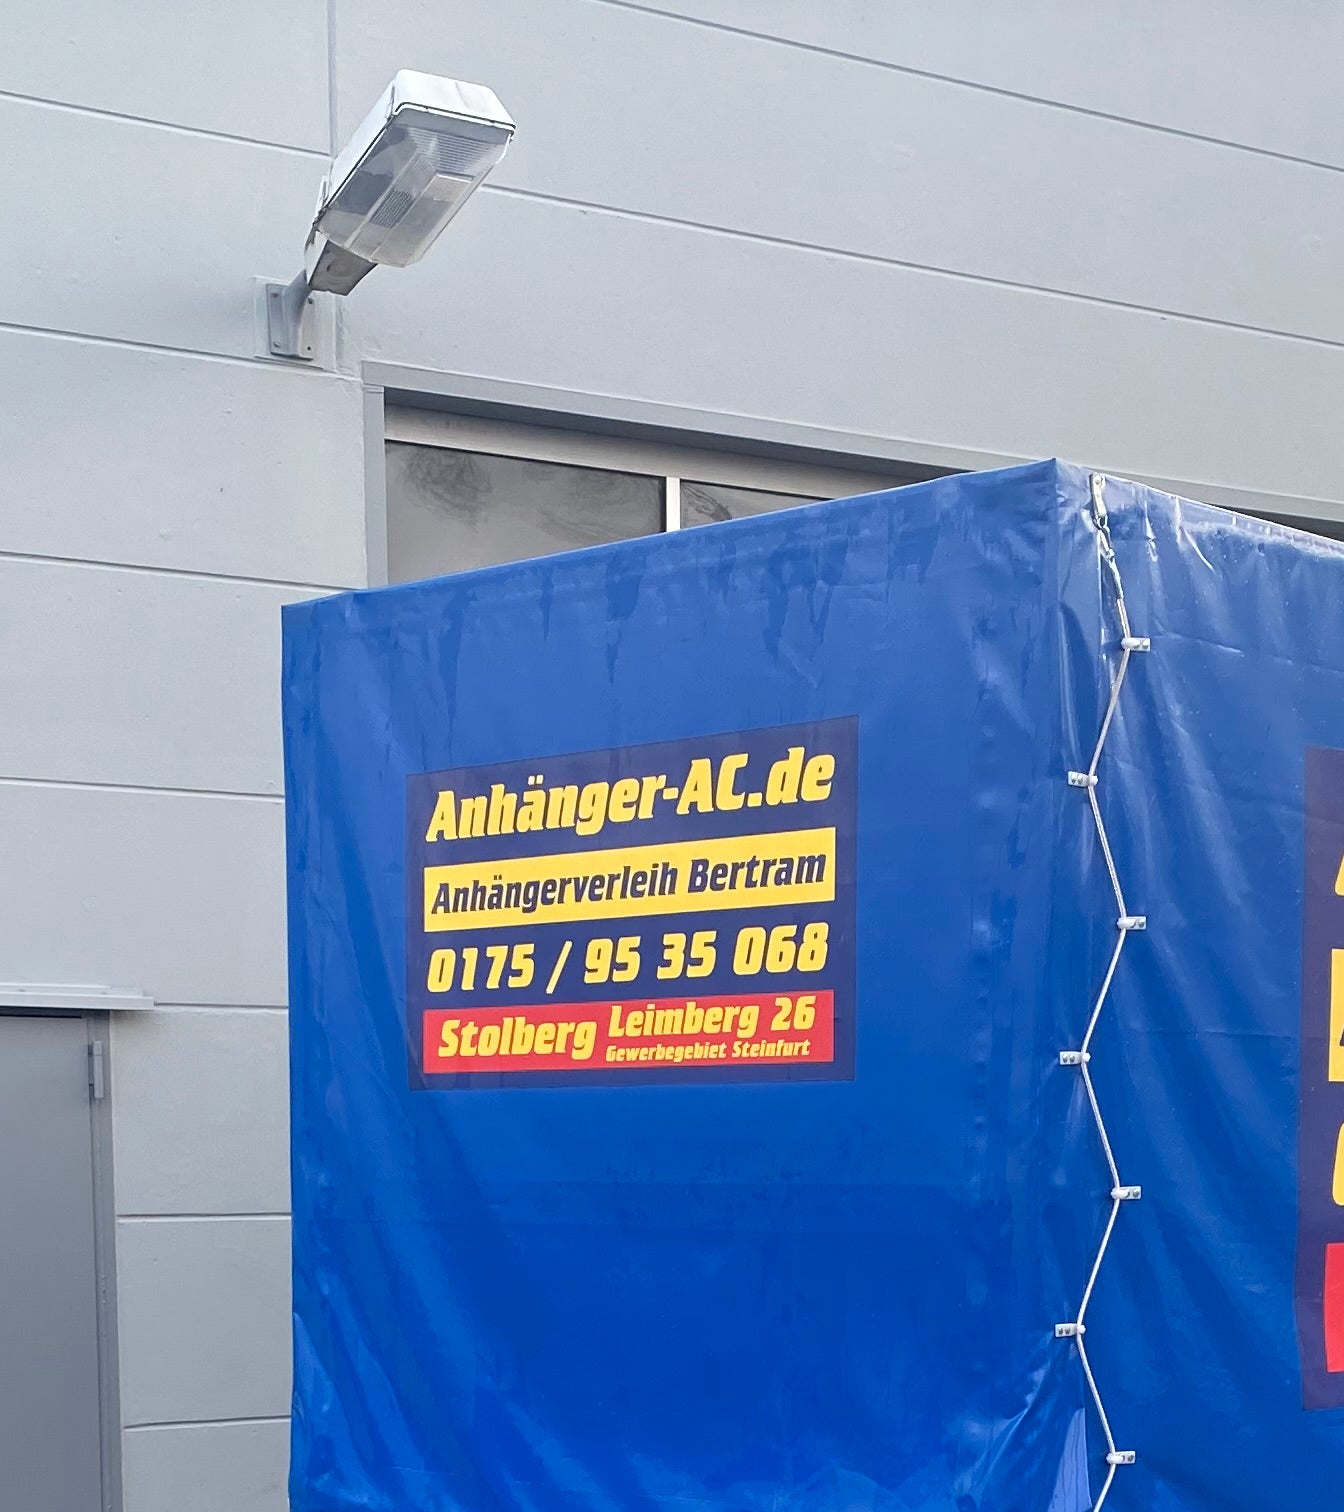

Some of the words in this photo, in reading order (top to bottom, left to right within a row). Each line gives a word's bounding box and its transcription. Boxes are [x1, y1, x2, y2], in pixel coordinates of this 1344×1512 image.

[426, 747, 836, 842] Anhänger-AC.de
[431, 864, 677, 914] Anhängerverleih
[687, 854, 826, 894] Bertram
[427, 943, 535, 993] 0175
[545, 940, 572, 995] /
[584, 936, 641, 983] 95
[656, 930, 717, 980] 35
[733, 922, 829, 976] 068
[438, 1018, 596, 1061] Stolberg
[608, 1000, 759, 1038] Leimberg
[770, 995, 816, 1030] 26
[605, 1041, 727, 1063] Gewerbegebiet
[732, 1039, 810, 1058] Steinfurt
